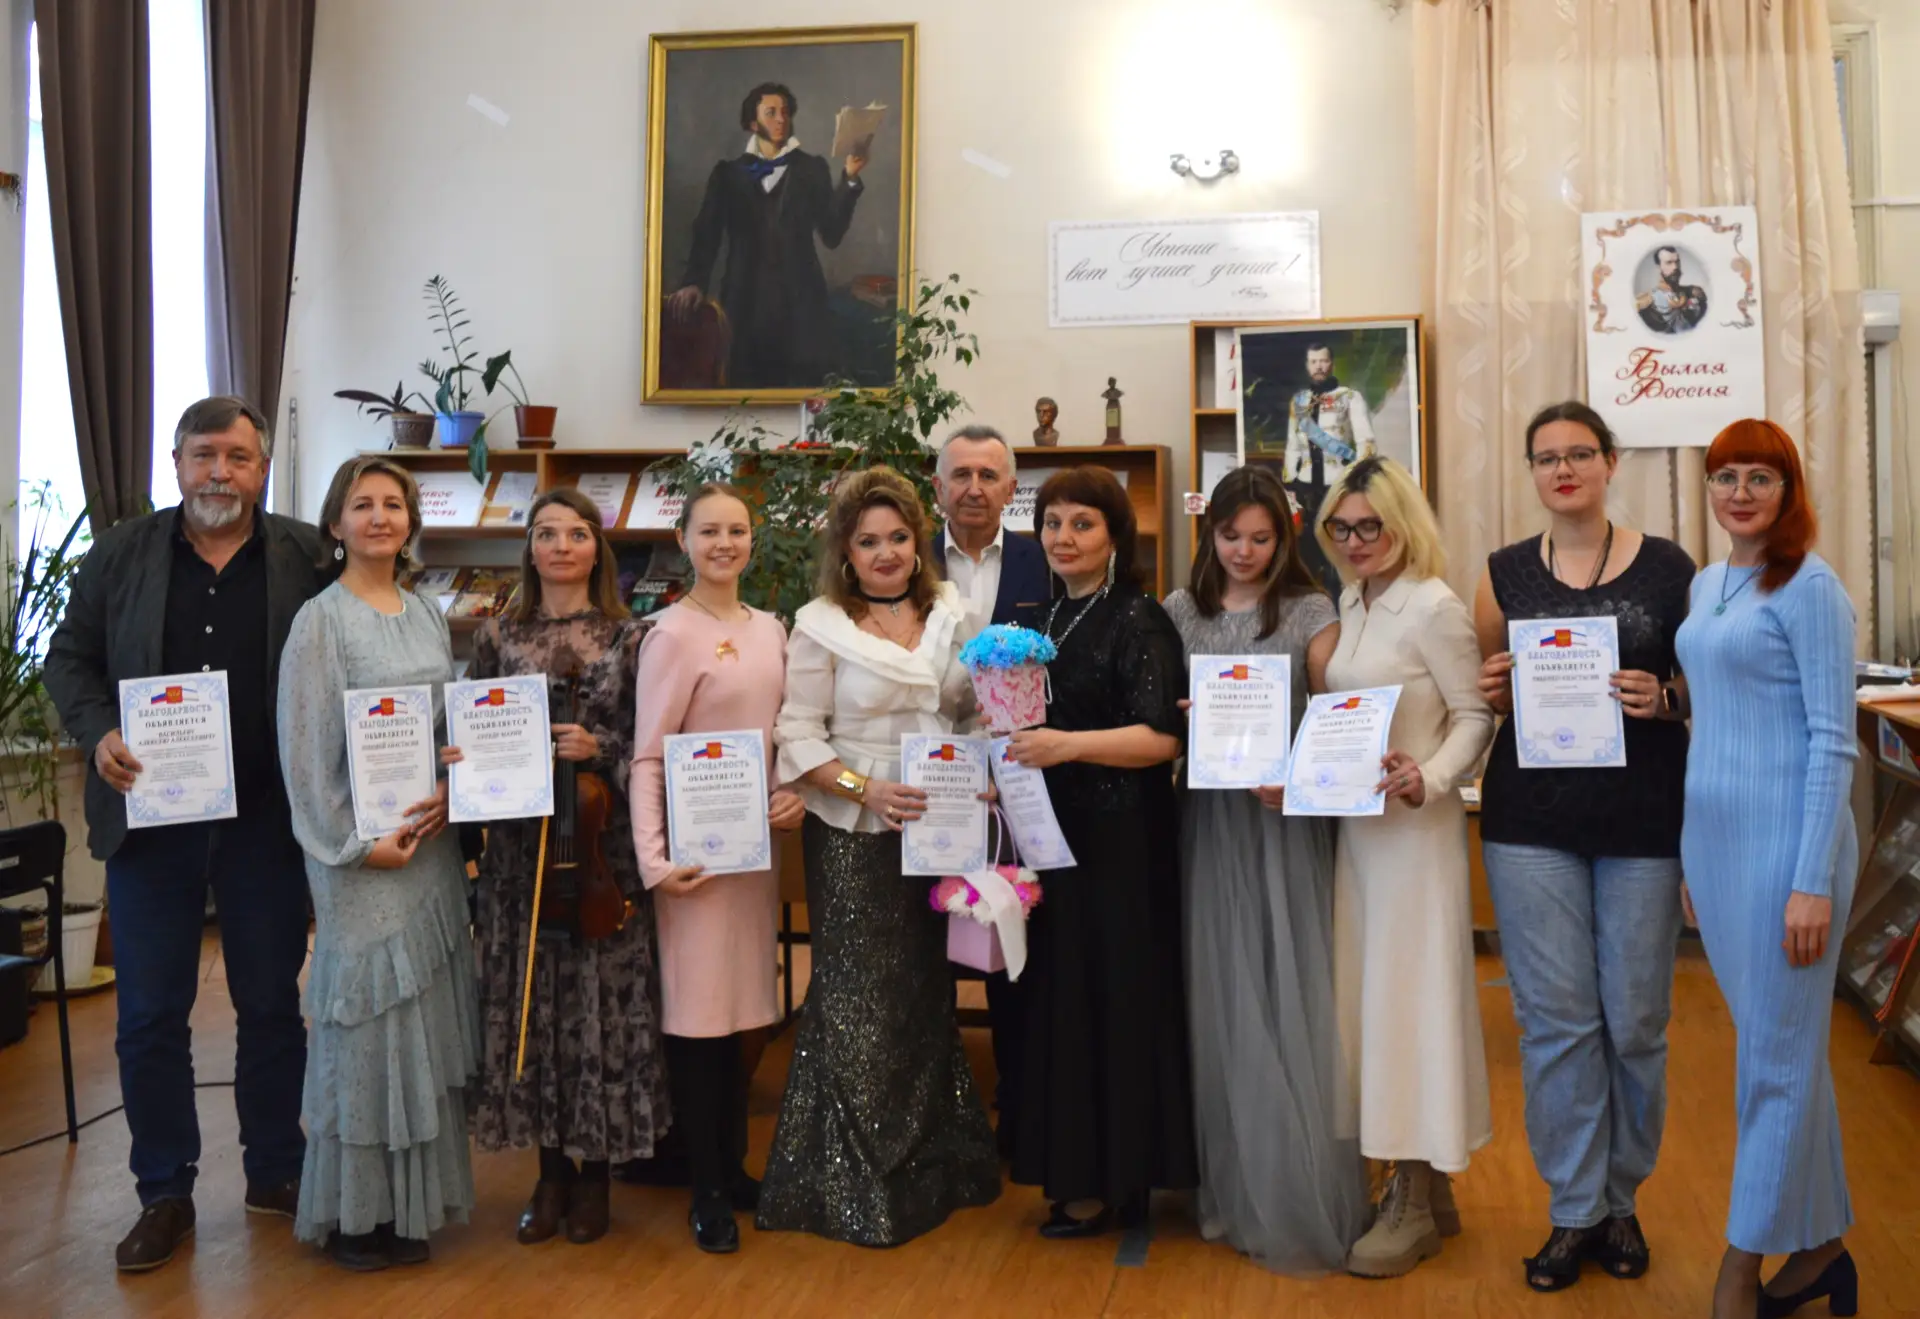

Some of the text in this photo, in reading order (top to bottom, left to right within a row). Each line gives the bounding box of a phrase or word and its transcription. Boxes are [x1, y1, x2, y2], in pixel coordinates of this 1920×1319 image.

[1119, 232, 1219, 264] Чтение
[1065, 258, 1108, 282] вот
[1117, 264, 1196, 291] лучшее
[1615, 346, 1728, 381] Былая
[1615, 377, 1730, 406] Россия
[138, 704, 212, 718] БЛАГОДАРНОСТЬ
[463, 706, 533, 720] БЛАГОДАРНОСТЬ
[145, 718, 207, 728] ОБЪЯВЛЯЕТСЯ
[470, 718, 528, 730] ОБЪЯВЛЯЕТСЯ
